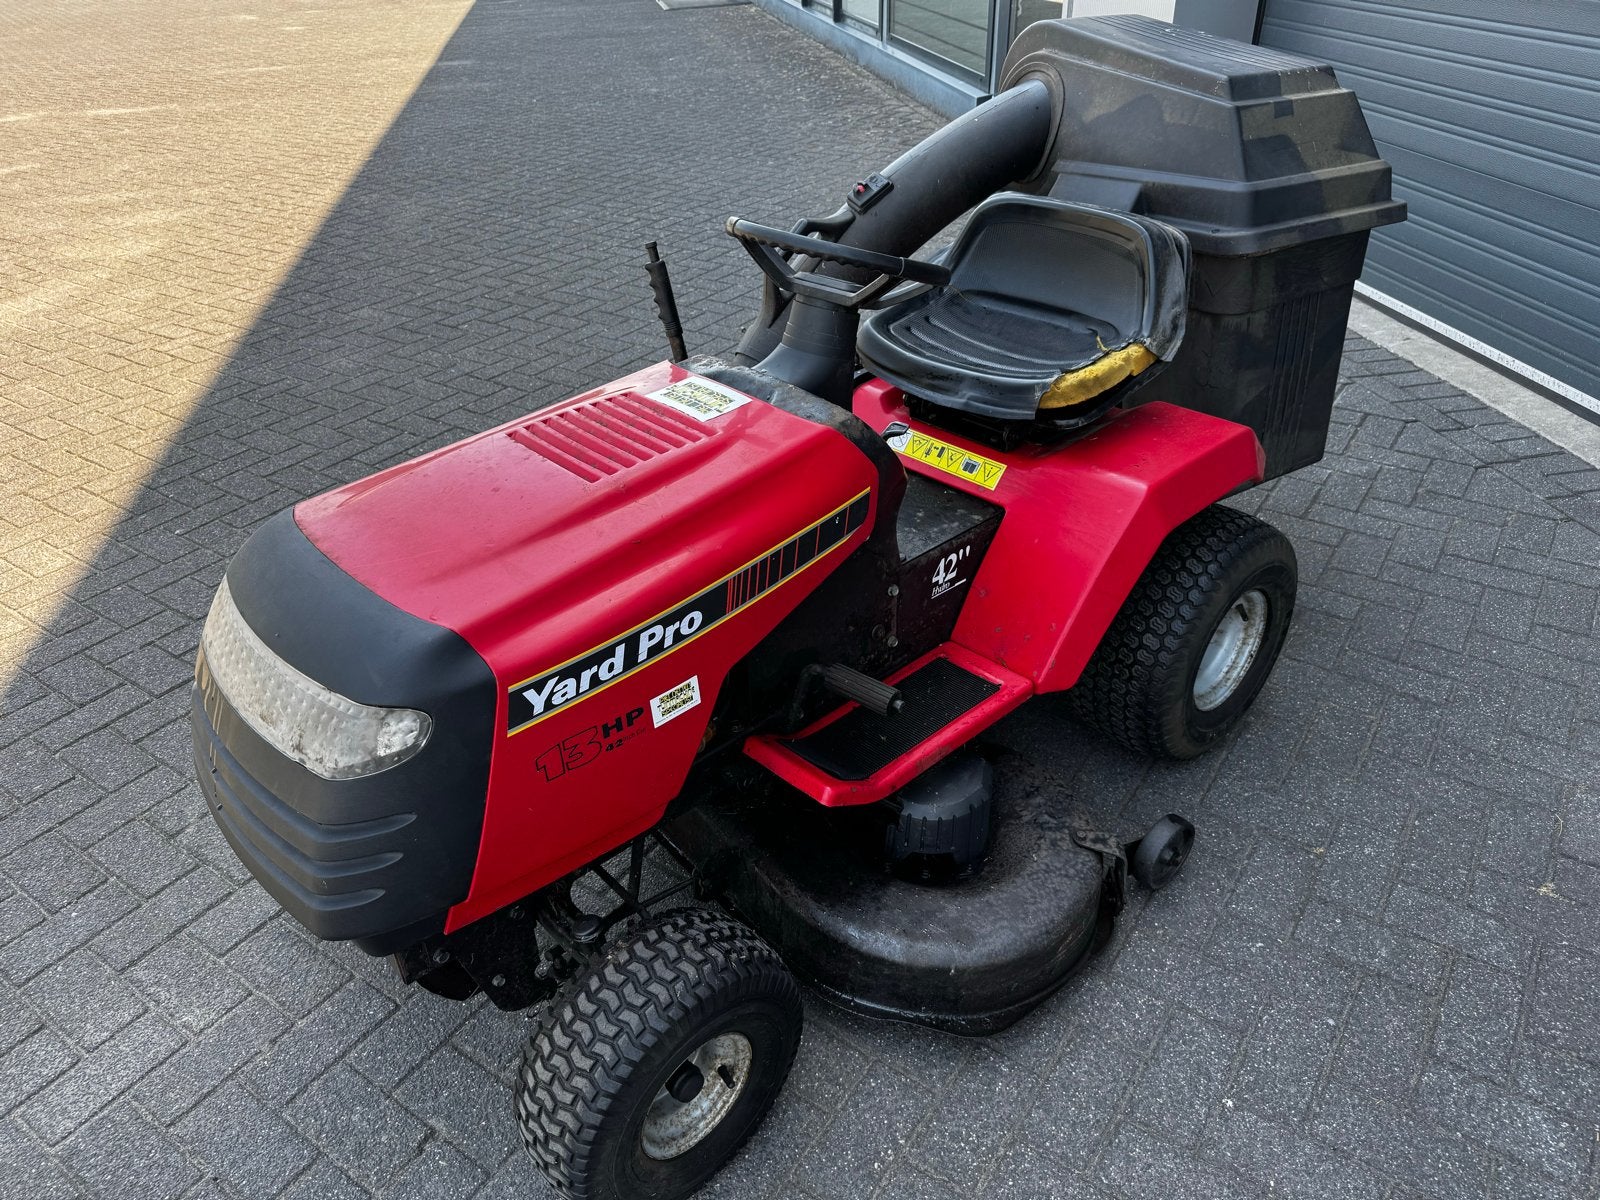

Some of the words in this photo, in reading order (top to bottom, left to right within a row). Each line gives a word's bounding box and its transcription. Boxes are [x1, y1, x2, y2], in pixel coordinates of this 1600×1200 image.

[522, 643, 626, 717] Yard
[637, 610, 703, 663] Pro
[535, 725, 602, 783] 13
[601, 706, 644, 739] HP
[605, 738, 623, 752] 42
